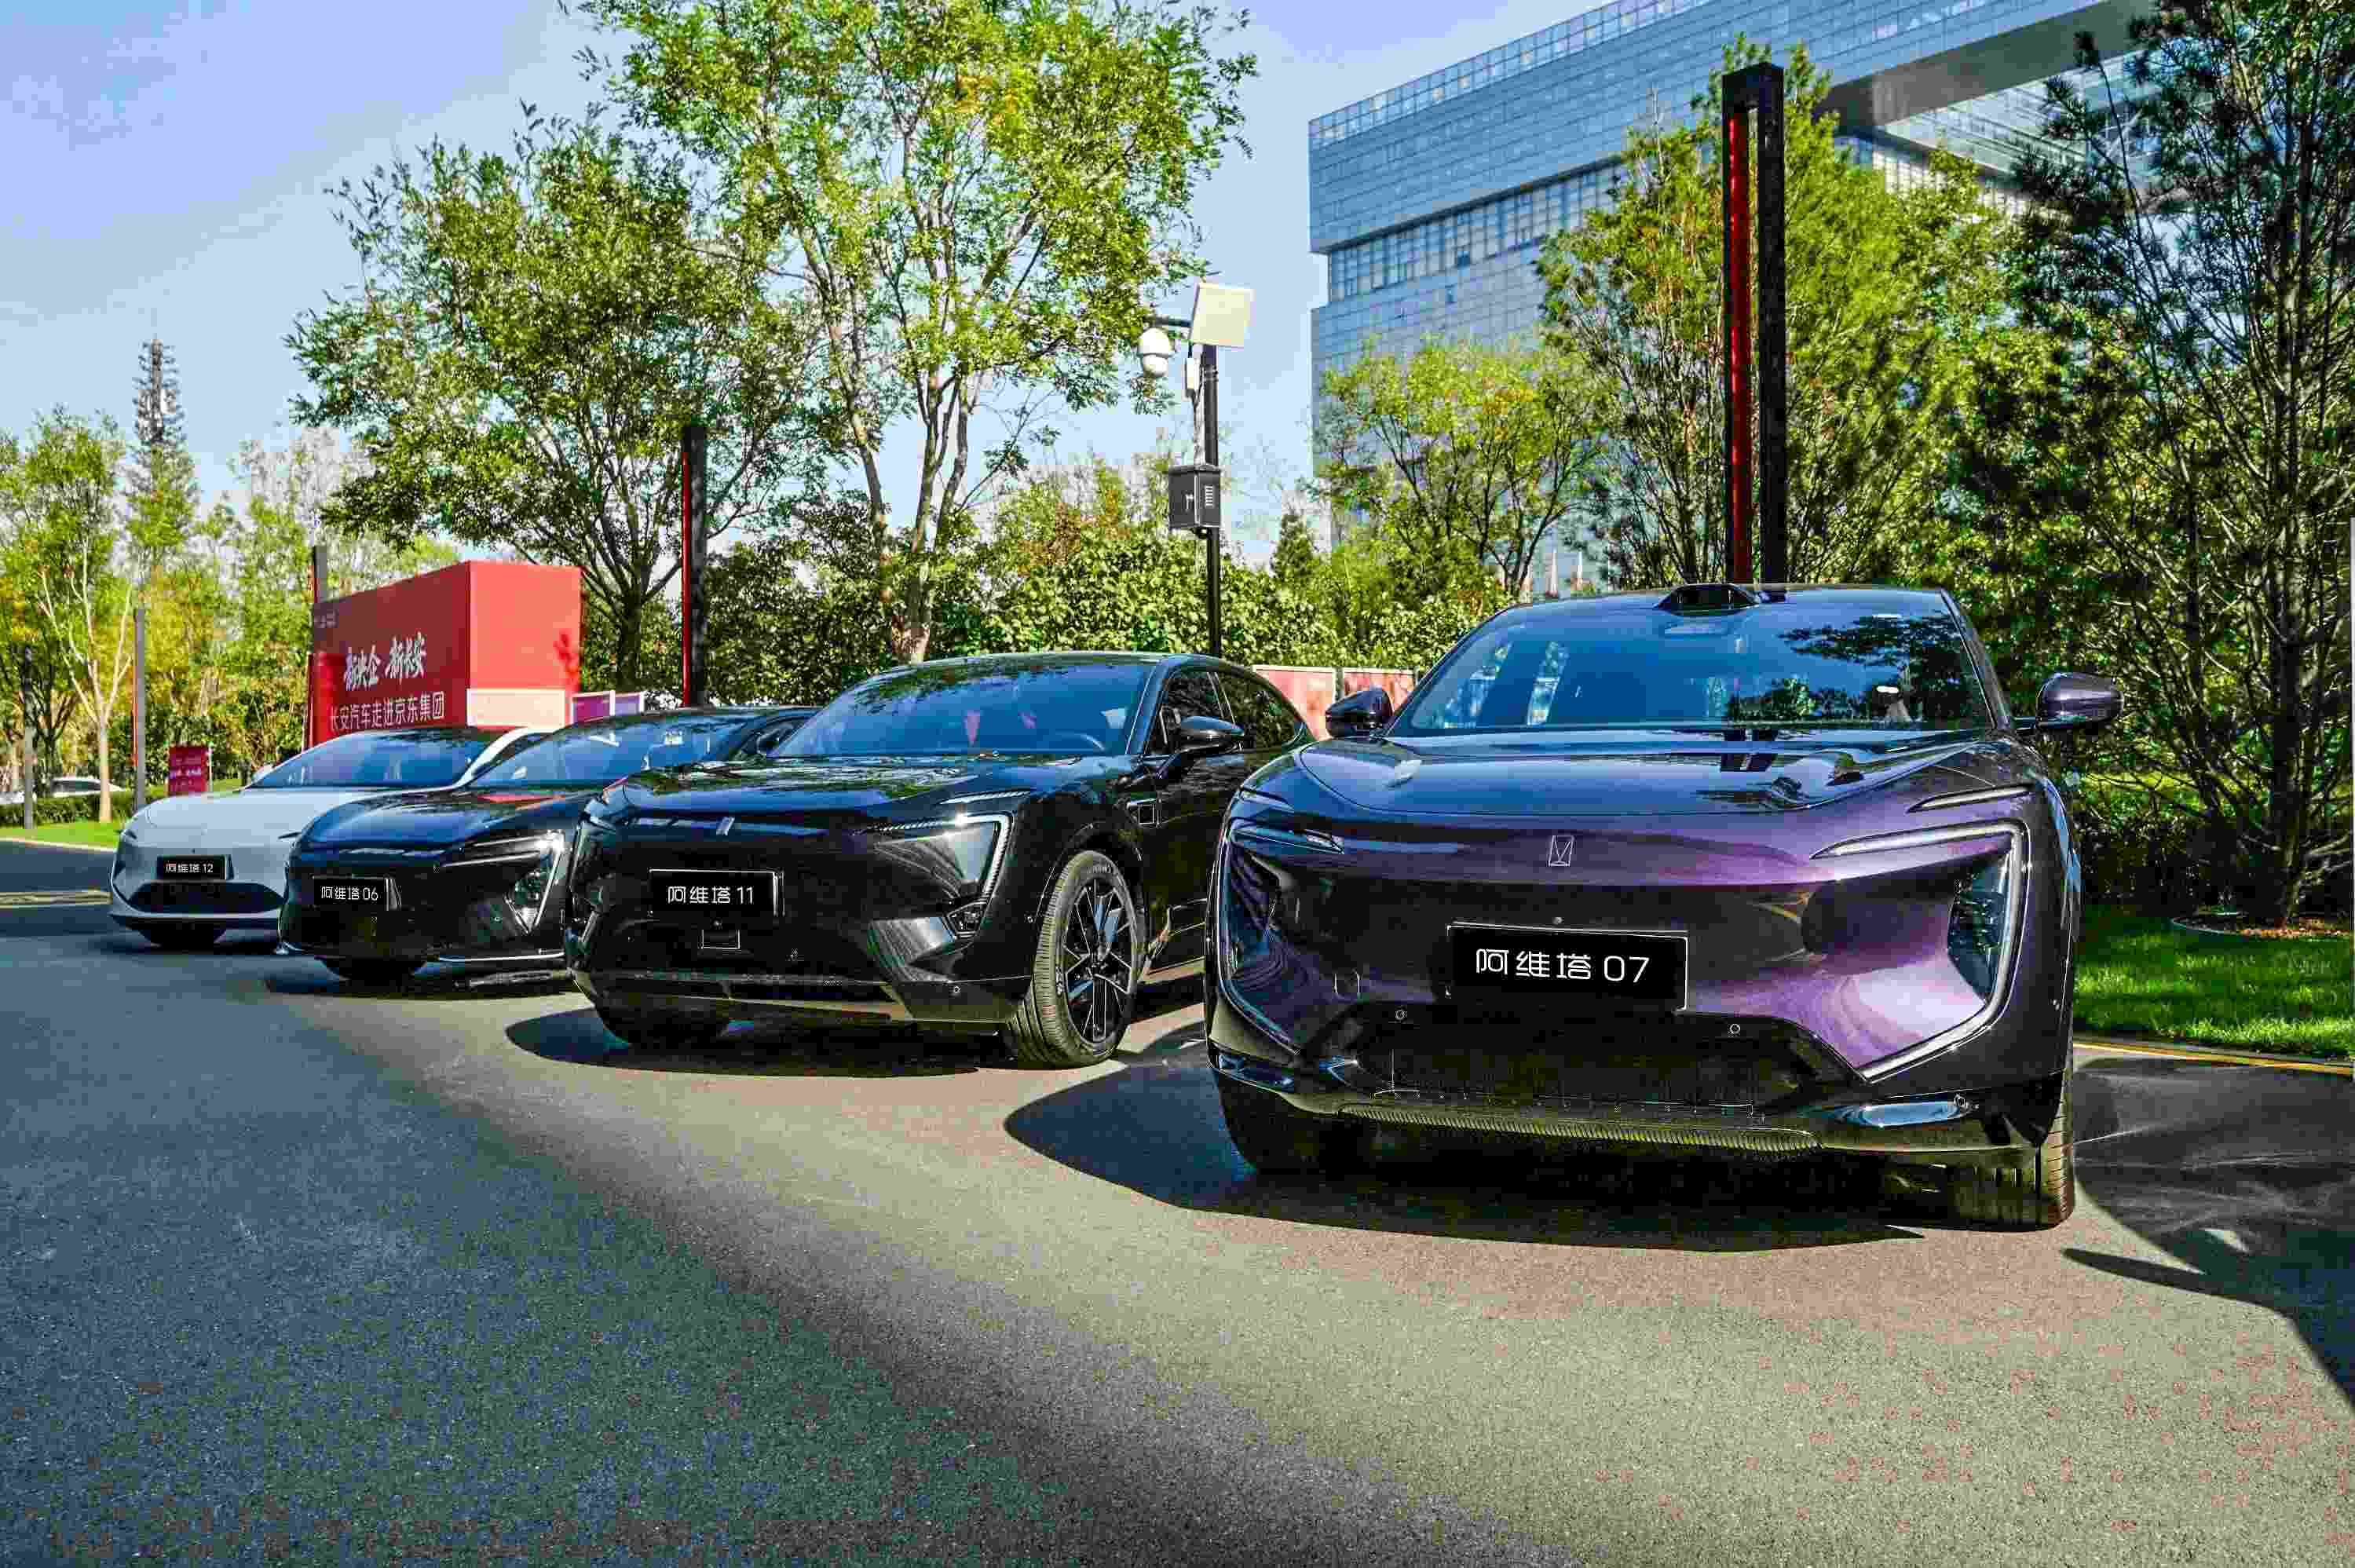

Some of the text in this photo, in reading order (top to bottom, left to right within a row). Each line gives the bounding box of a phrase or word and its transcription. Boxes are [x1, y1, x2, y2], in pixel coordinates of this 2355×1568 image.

[330, 690, 445, 733] 长安汽车走进京东集团
[166, 863, 214, 873] 阿维塔 12
[321, 886, 378, 901] 阿维塔 06
[667, 886, 754, 905] 阿维塔 11
[1476, 948, 1650, 983] 阿维塔 07
